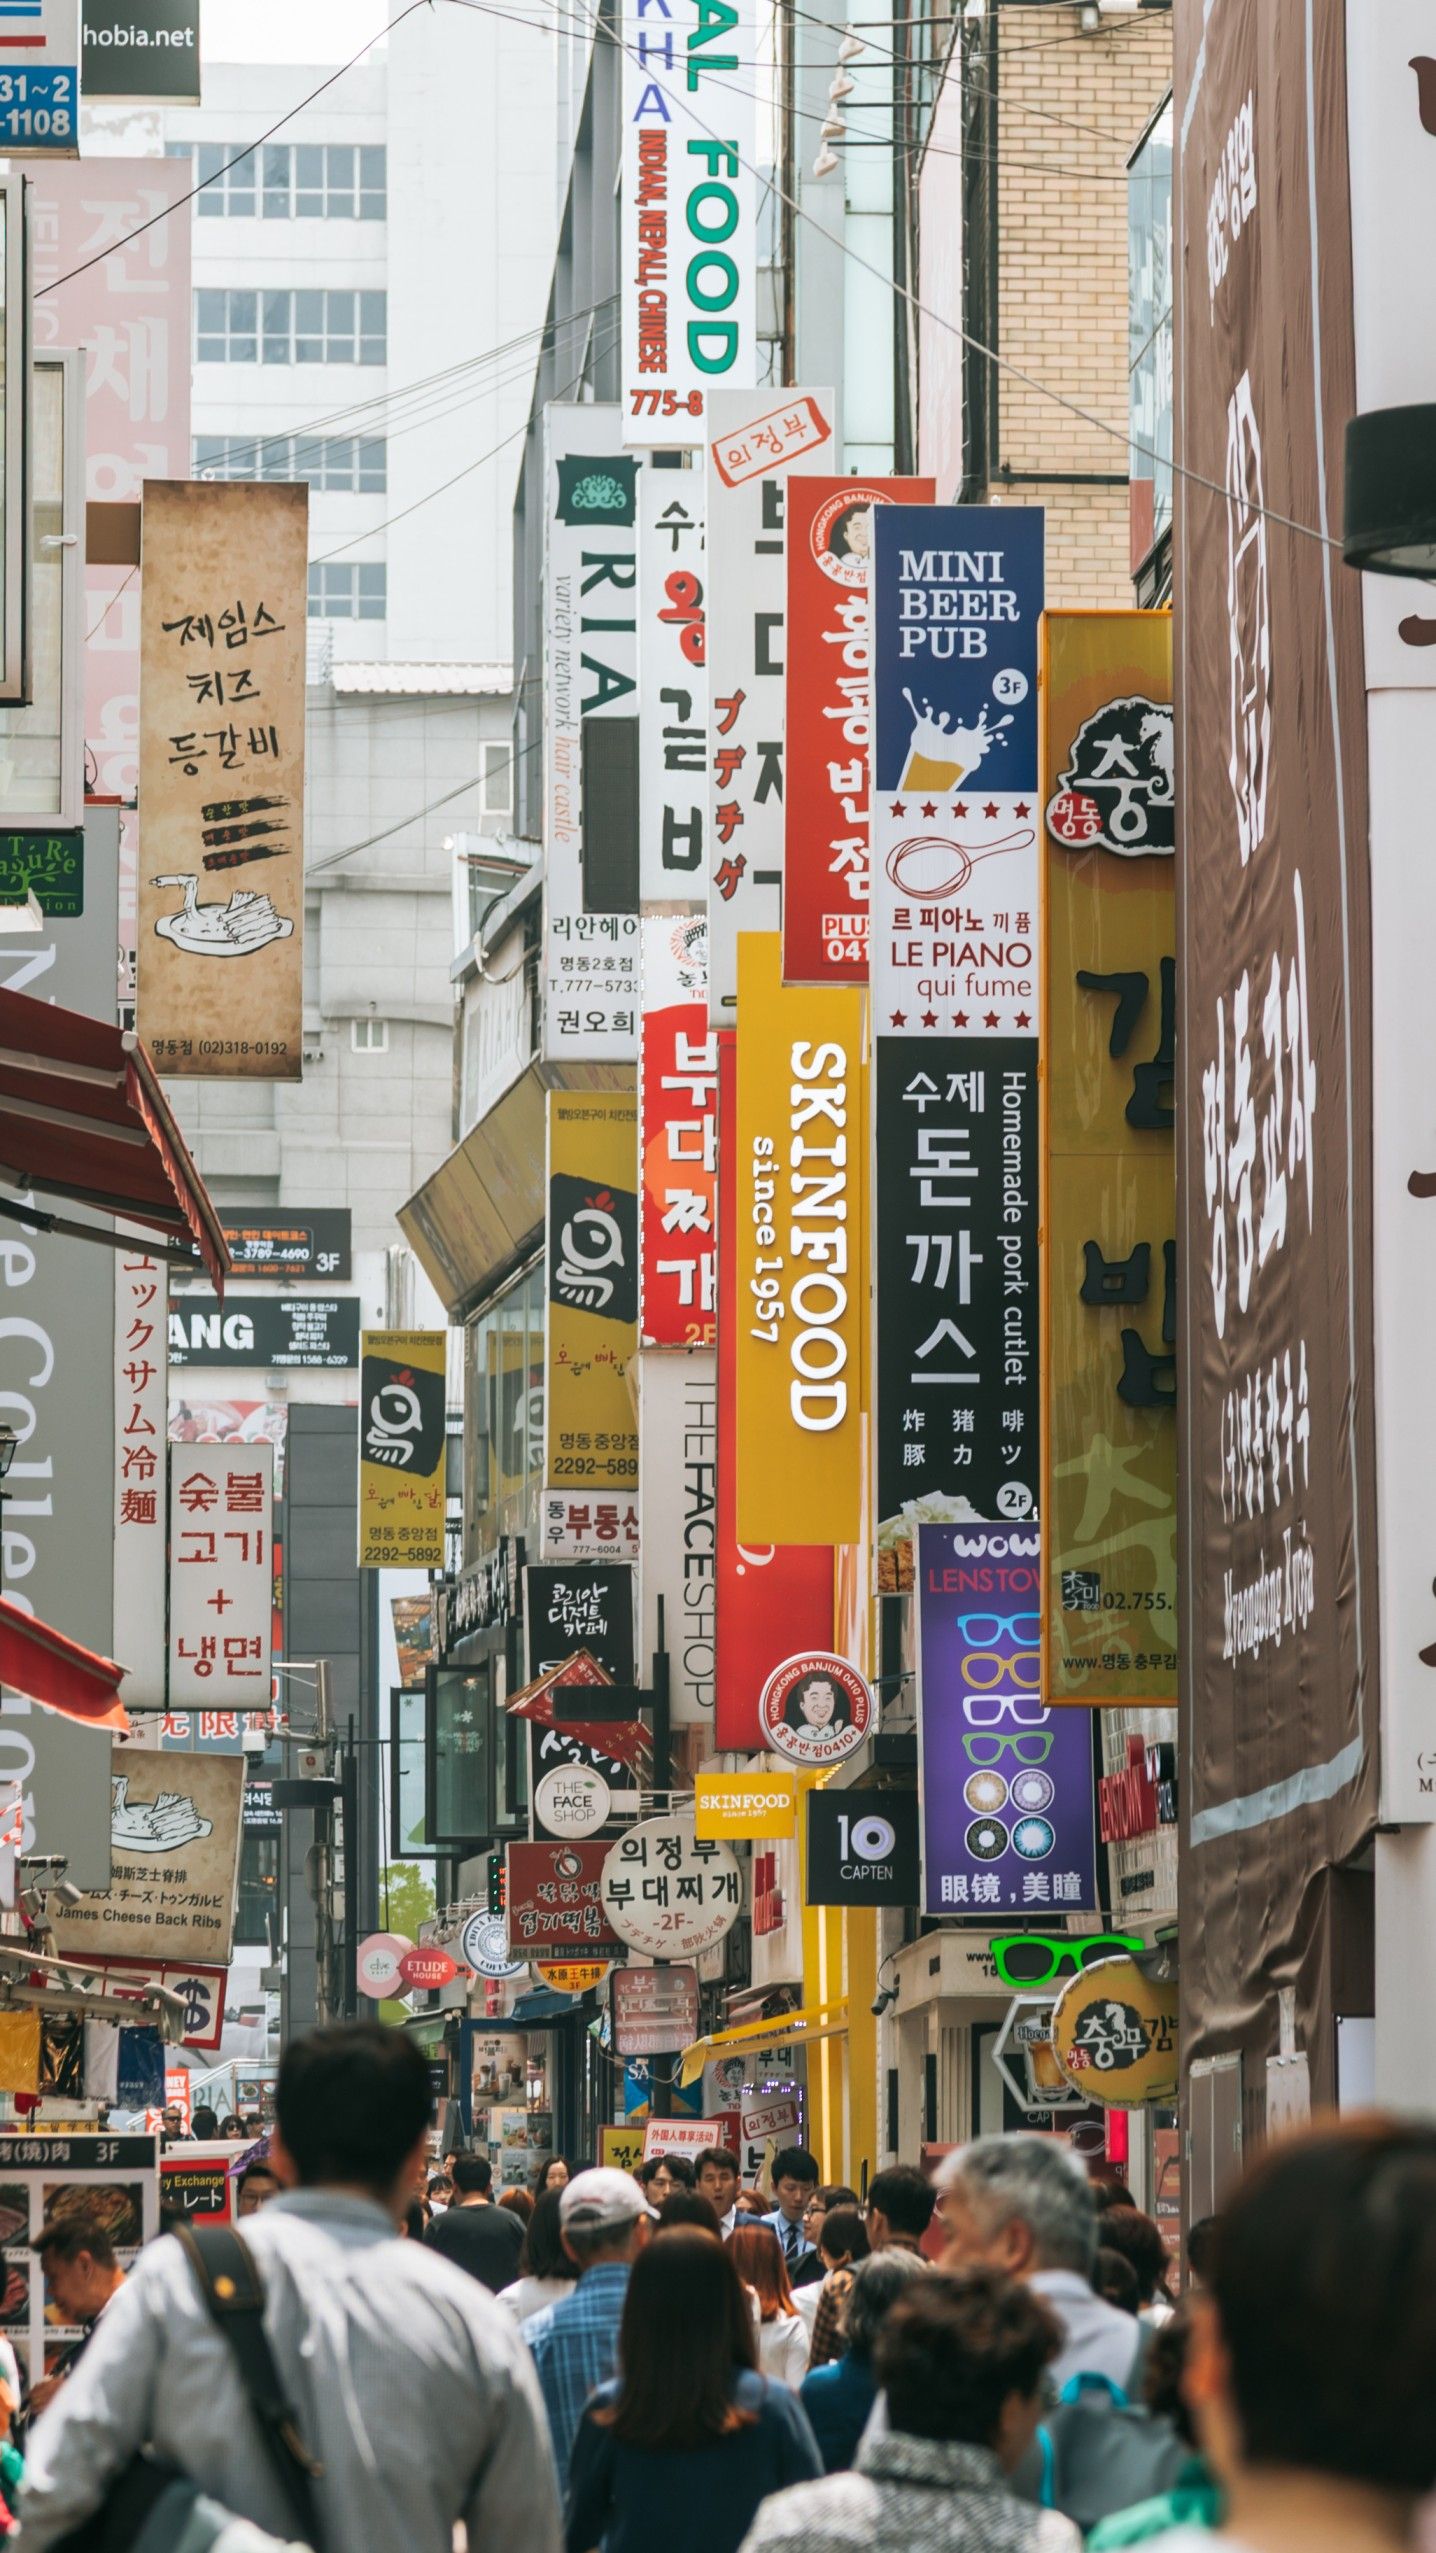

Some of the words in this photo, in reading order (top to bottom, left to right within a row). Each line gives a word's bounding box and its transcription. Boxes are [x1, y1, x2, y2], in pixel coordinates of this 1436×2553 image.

[83, 24, 195, 47] hobia.net
[634, 129, 667, 207] INDIAN,
[686, 140, 740, 375] FOOD
[638, 289, 667, 374] CHINESE
[727, 413, 807, 470] 의정부
[655, 500, 706, 552] 수
[899, 550, 1004, 582] MINI
[554, 575, 578, 646] variety
[899, 588, 1021, 622] BEER
[162, 600, 286, 649] 제임스
[899, 626, 988, 659] PUB
[186, 669, 260, 706] 치즈
[554, 647, 580, 731] network
[999, 676, 1022, 695] 3F
[168, 722, 279, 776] 등갈비
[554, 735, 578, 779] hair
[821, 594, 869, 901] 홍콩반점
[554, 784, 578, 843] castle
[1055, 798, 1101, 837] 명동
[891, 907, 913, 931] 르
[919, 907, 985, 934] 피아노
[560, 956, 634, 973] 명동2호점
[891, 941, 923, 967] LE
[932, 941, 1033, 968] PIANO
[917, 973, 956, 1003] qui
[965, 972, 1032, 998] fume
[556, 1010, 635, 1036] 권오희
[152, 1039, 193, 1056] 명동점
[198, 1040, 288, 1057] (02)318-0192
[902, 1070, 985, 1114] 수제
[1002, 1071, 1029, 1224] Homemade
[752, 1135, 780, 1247] since
[790, 1040, 848, 1431] SKINFOOD
[316, 1252, 341, 1272] 3F
[905, 1129, 985, 1384] 돈까스
[997, 1235, 1029, 1296] pork
[749, 1255, 785, 1344] 1957
[1004, 1305, 1030, 1386] cutlet
[560, 1433, 592, 1450] 명동
[179, 1472, 265, 1513] 숯불
[1004, 1489, 1027, 1508] 2F
[178, 1530, 264, 1566] 고기
[369, 1527, 395, 1542] 명동
[398, 1526, 438, 1542] 중앙점
[364, 1547, 442, 1562] 2292-5892
[552, 1581, 609, 1606] 코리안
[548, 1602, 602, 1624] 디저트
[563, 1619, 609, 1638] 카페
[178, 1635, 263, 1678] 냉면
[770, 1667, 801, 1722] HONGKONG
[800, 1661, 844, 1677] BANJUM
[842, 1673, 862, 1696] 0410
[854, 1696, 865, 1725] PLUS
[554, 1781, 584, 1794] THE
[554, 1795, 593, 1809] FACE
[699, 1793, 791, 1810] SKINFOOD
[554, 1809, 596, 1823] SHOP
[620, 1835, 720, 1871] 의정부
[840, 1864, 894, 1880] CAPTEN
[606, 1872, 739, 1911] 부대찌개
[56, 1906, 99, 1920] James
[103, 1908, 151, 1924] Cheese
[155, 1912, 188, 1927] Back
[192, 1915, 222, 1929] Ribs
[520, 1905, 609, 1938] 엽기떡볶
[407, 1961, 449, 1973] ETUDE
[96, 2143, 120, 2163] 3F
[174, 2174, 225, 2188] Exchange
